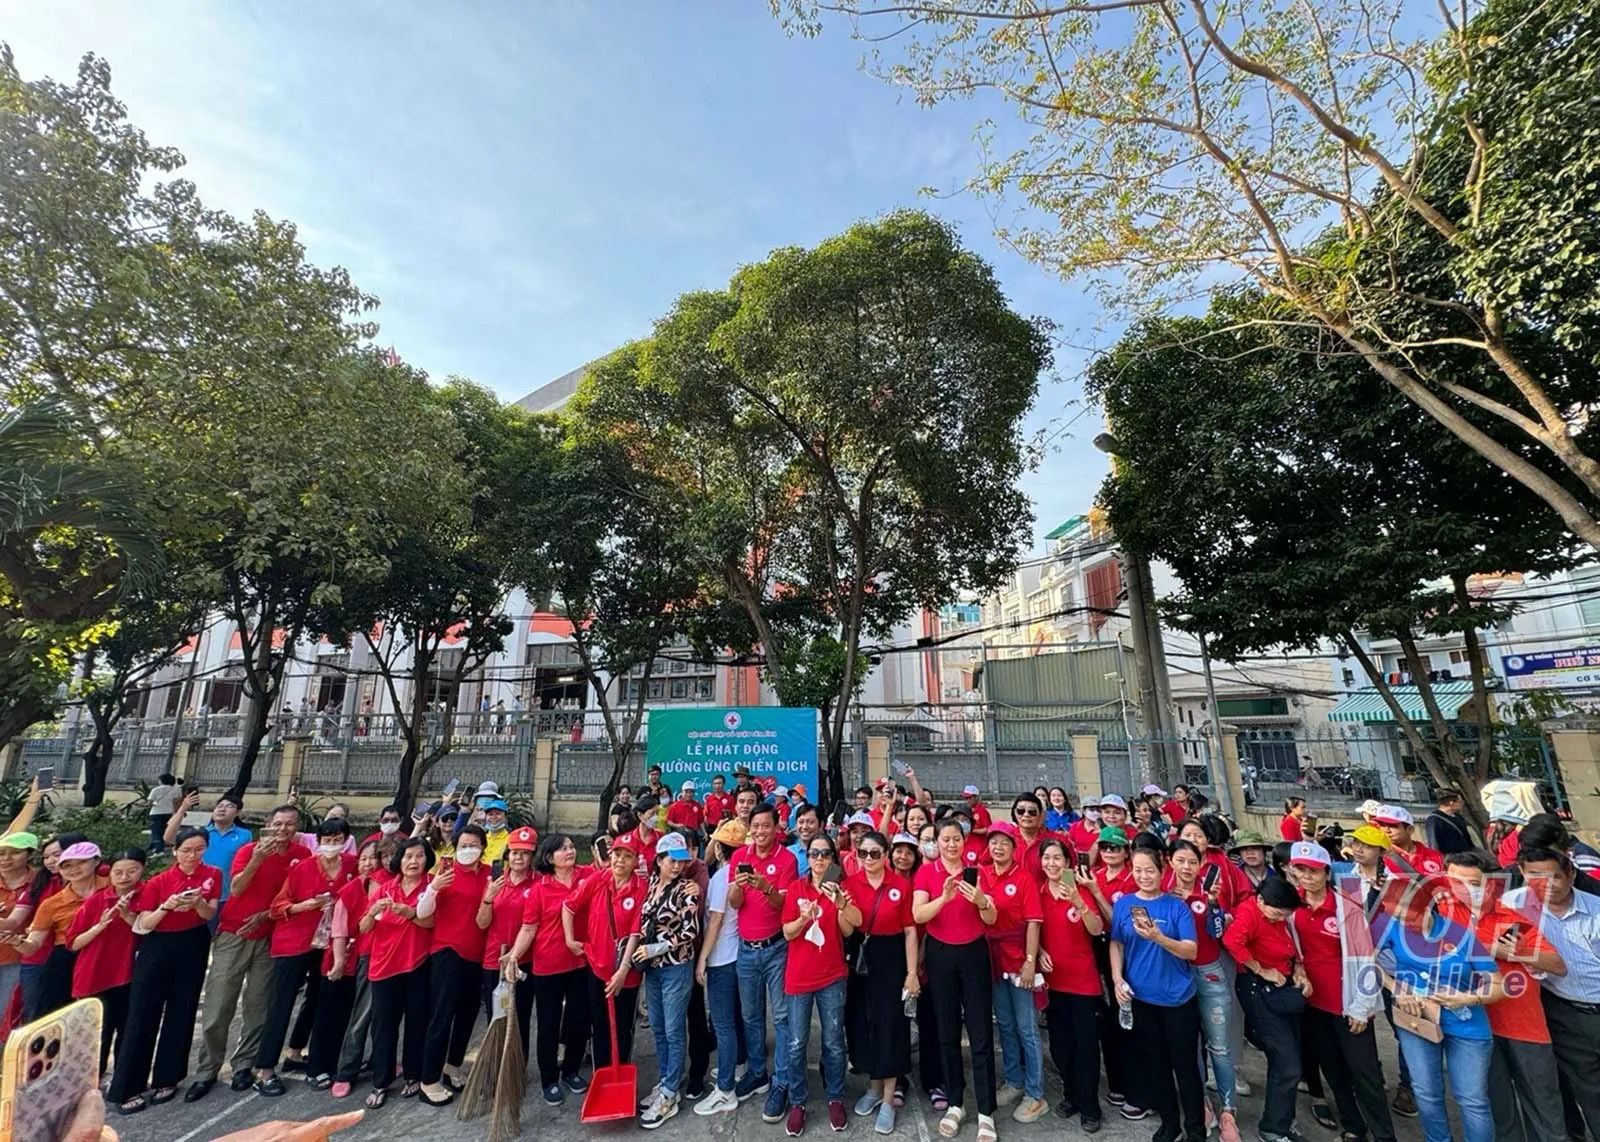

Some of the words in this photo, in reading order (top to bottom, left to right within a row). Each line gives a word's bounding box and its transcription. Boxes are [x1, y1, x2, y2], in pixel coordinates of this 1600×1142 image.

[687, 740, 702, 755] LỄ
[706, 742, 739, 755] PHÁT
[743, 741, 778, 757] ĐỘNG
[704, 759, 730, 772] ỨNG
[777, 761, 808, 774] DỊCH
